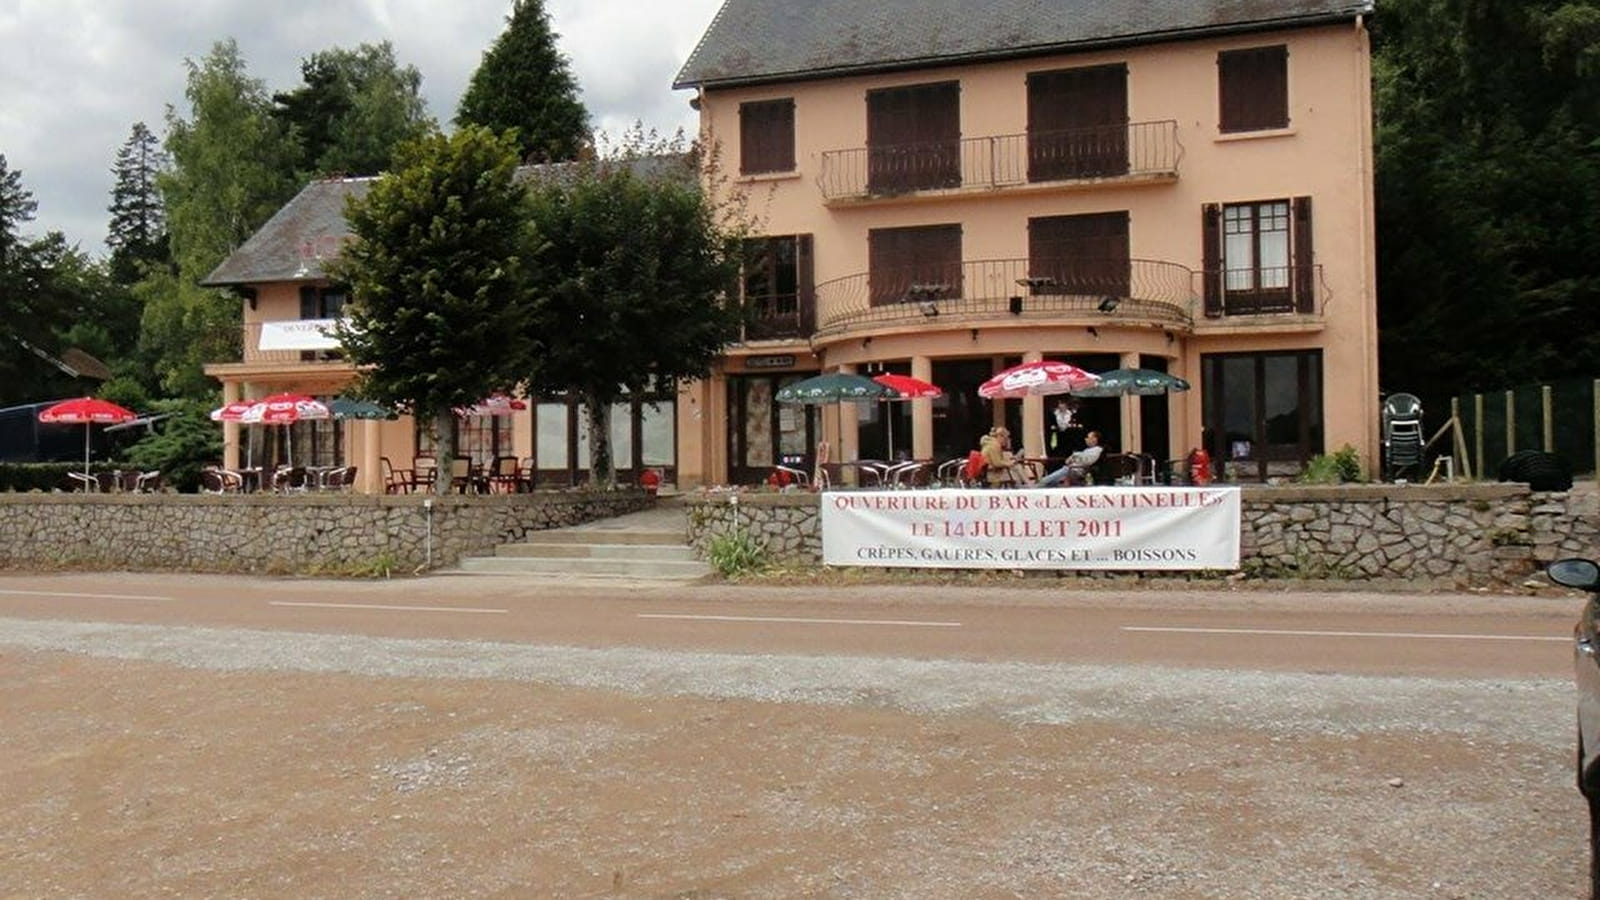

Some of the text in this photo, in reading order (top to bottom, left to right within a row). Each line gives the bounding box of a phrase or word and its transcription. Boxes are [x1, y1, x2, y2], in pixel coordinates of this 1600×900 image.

[835, 495, 948, 510] OUVERTURE
[956, 495, 981, 510] DU
[989, 494, 1029, 509] BAR
[912, 519, 1122, 538] LE 14 JUILLET 2011
[857, 545, 917, 560] CRÊPES,
[921, 547, 998, 561] GAUFRES,
[1001, 548, 1067, 562] GLACES
[1071, 549, 1092, 561] ET
[1114, 548, 1196, 561] BOISSONS
